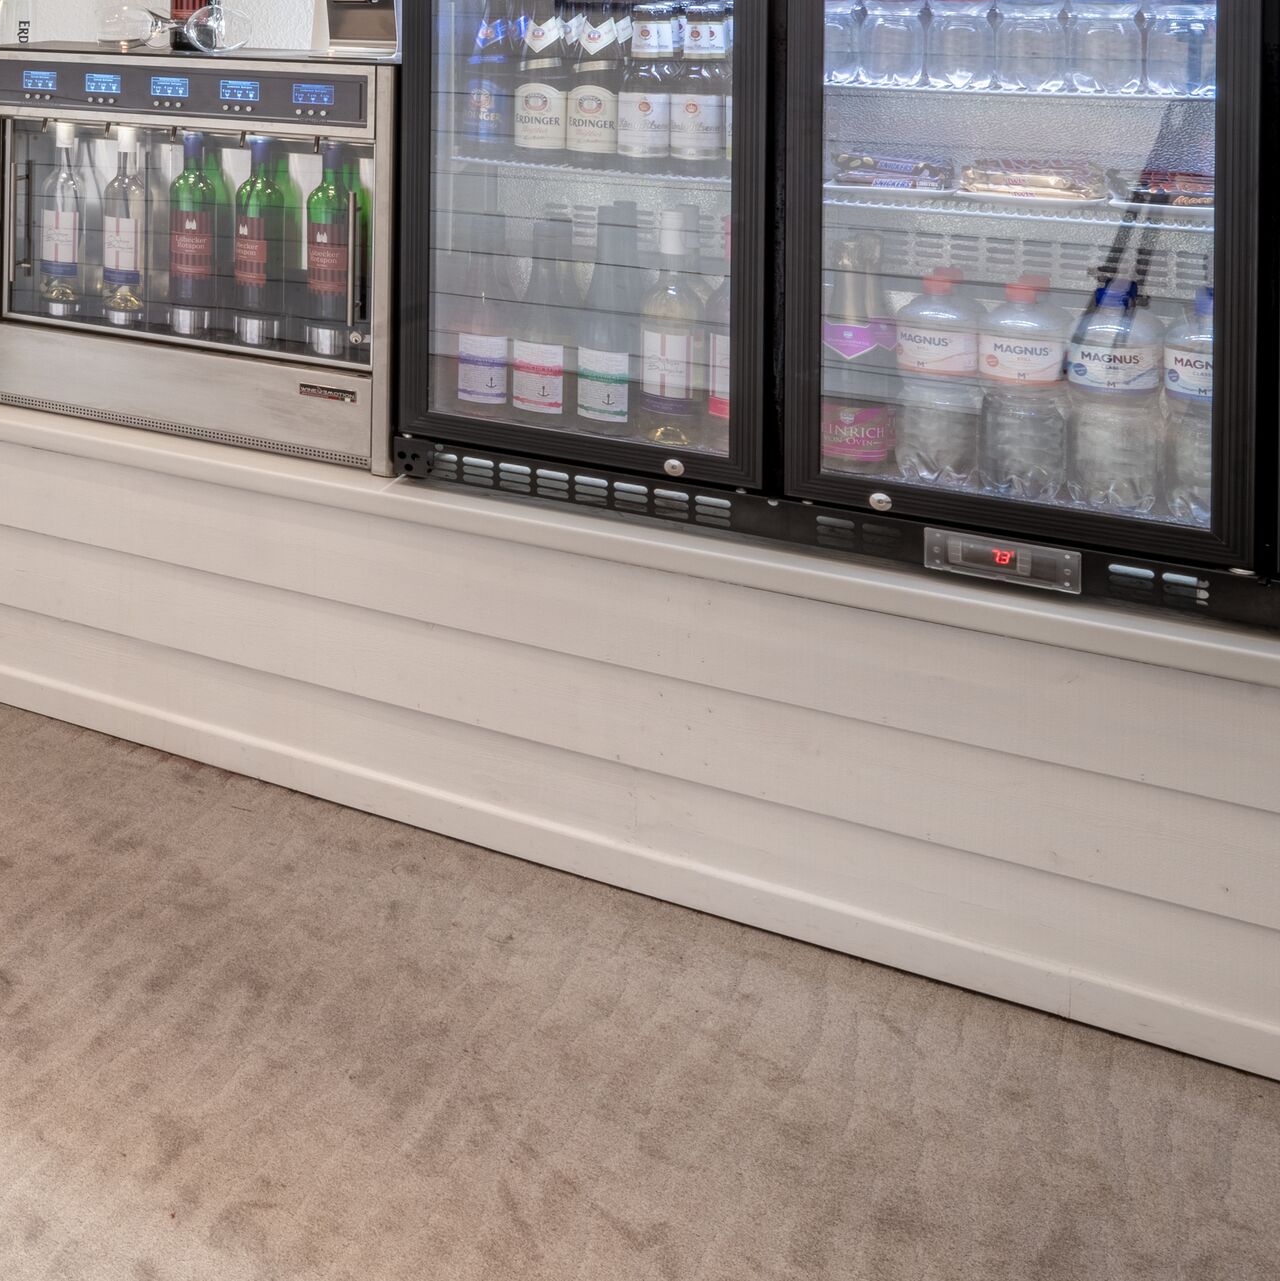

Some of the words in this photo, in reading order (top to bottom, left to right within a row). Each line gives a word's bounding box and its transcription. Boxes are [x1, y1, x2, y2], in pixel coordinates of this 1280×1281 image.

[515, 114, 561, 126] ERDINGER
[568, 116, 616, 129] ERDINGER
[873, 179, 913, 188] SNICKERS
[900, 331, 949, 347] MAGNUS
[994, 343, 1049, 357] MAGNUS
[1081, 351, 1140, 365] MAGNUS
